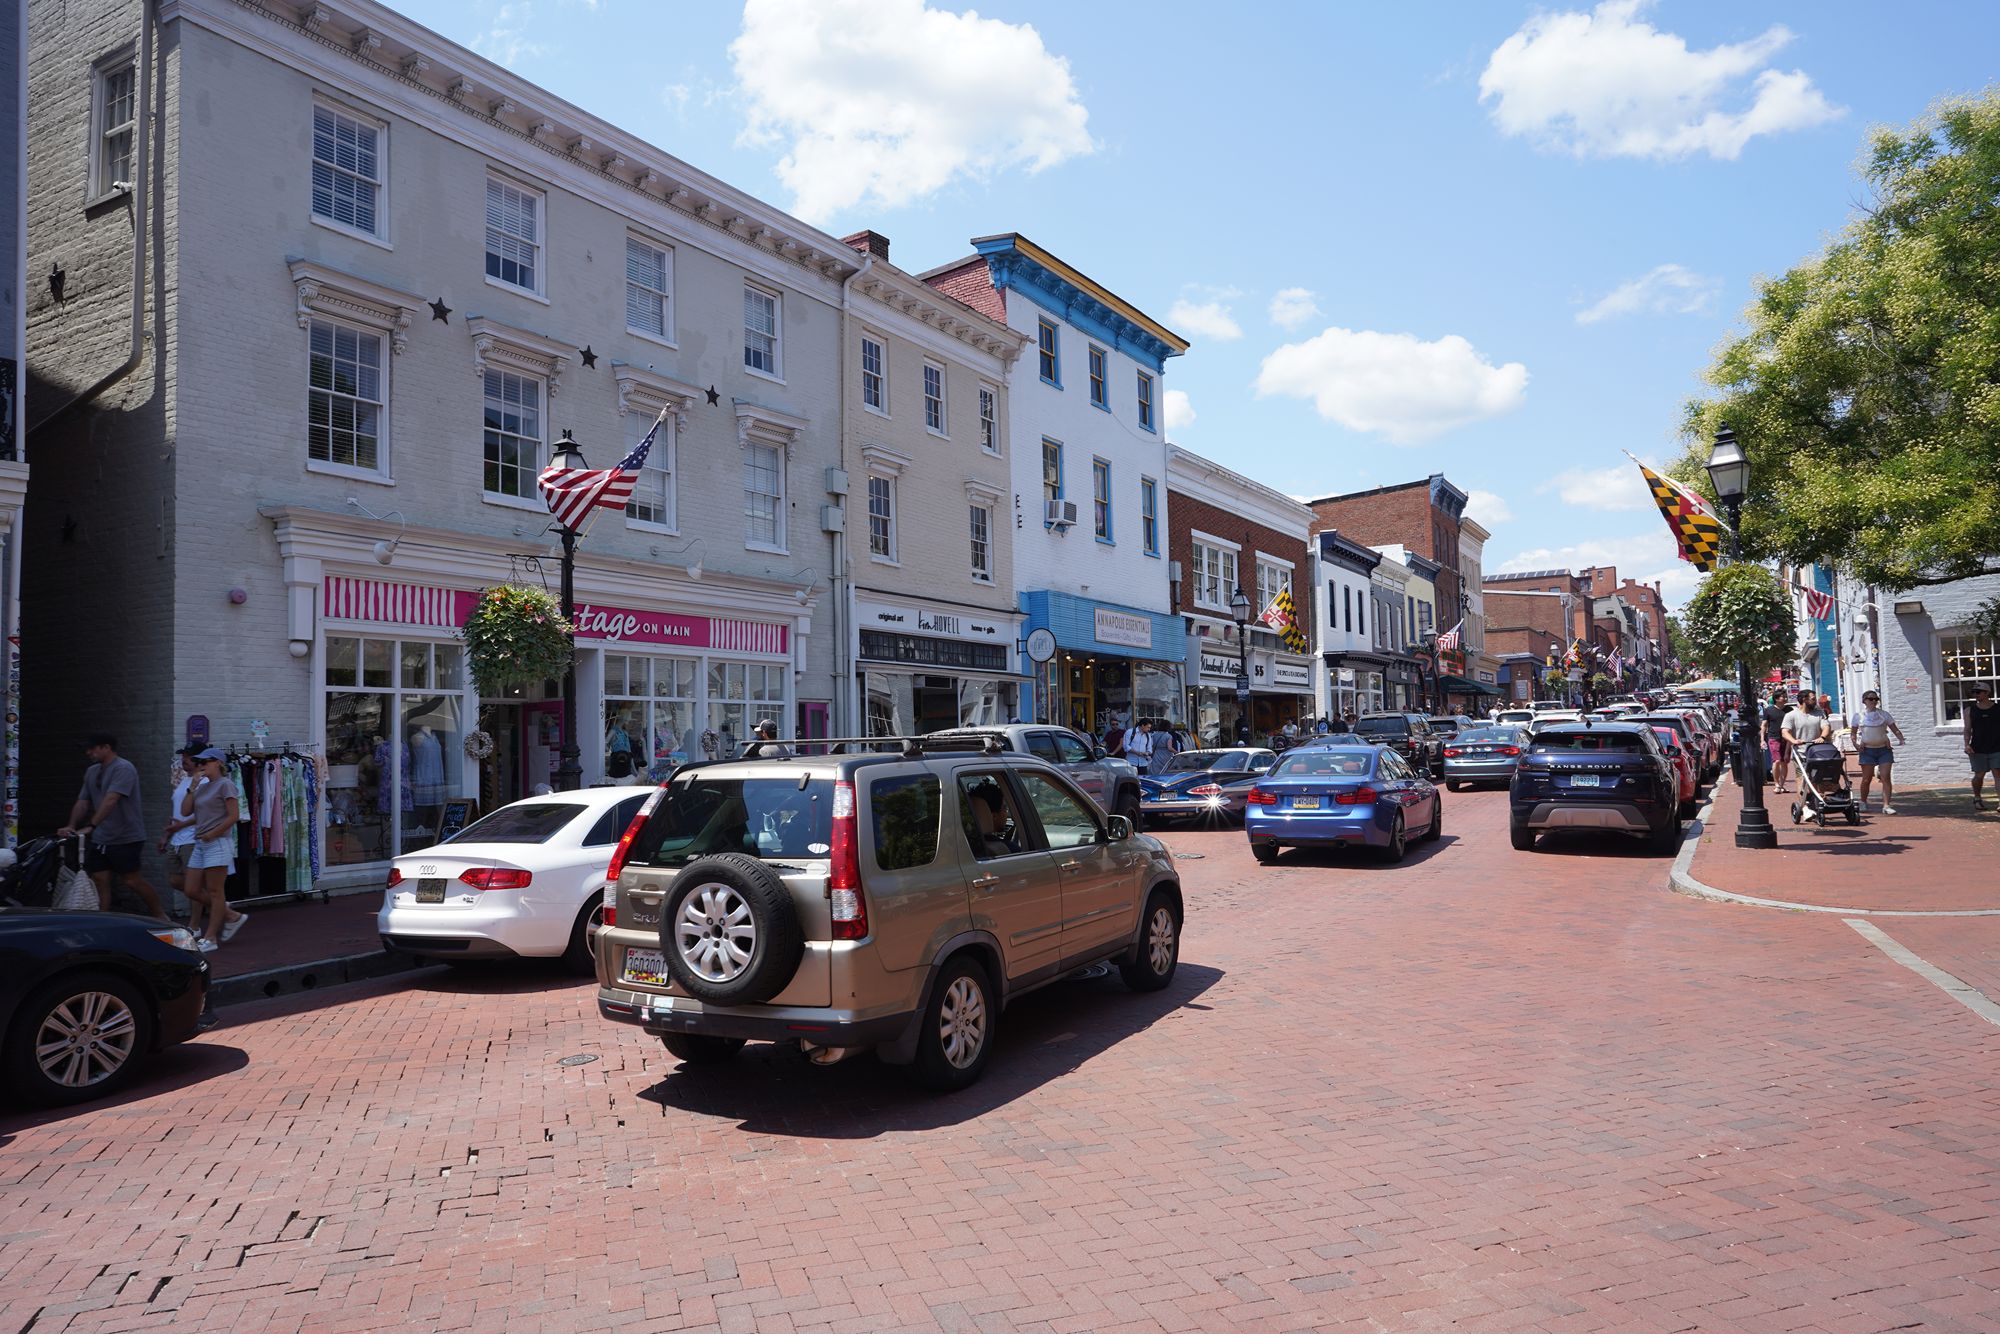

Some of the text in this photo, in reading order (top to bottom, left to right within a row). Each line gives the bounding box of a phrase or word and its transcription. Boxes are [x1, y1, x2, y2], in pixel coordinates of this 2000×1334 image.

[642, 623, 658, 634] ON
[663, 625, 690, 637] MAIN
[934, 615, 960, 635] HOVELL
[1097, 613, 1150, 634] ANNAPOLIS ESSENTIALS
